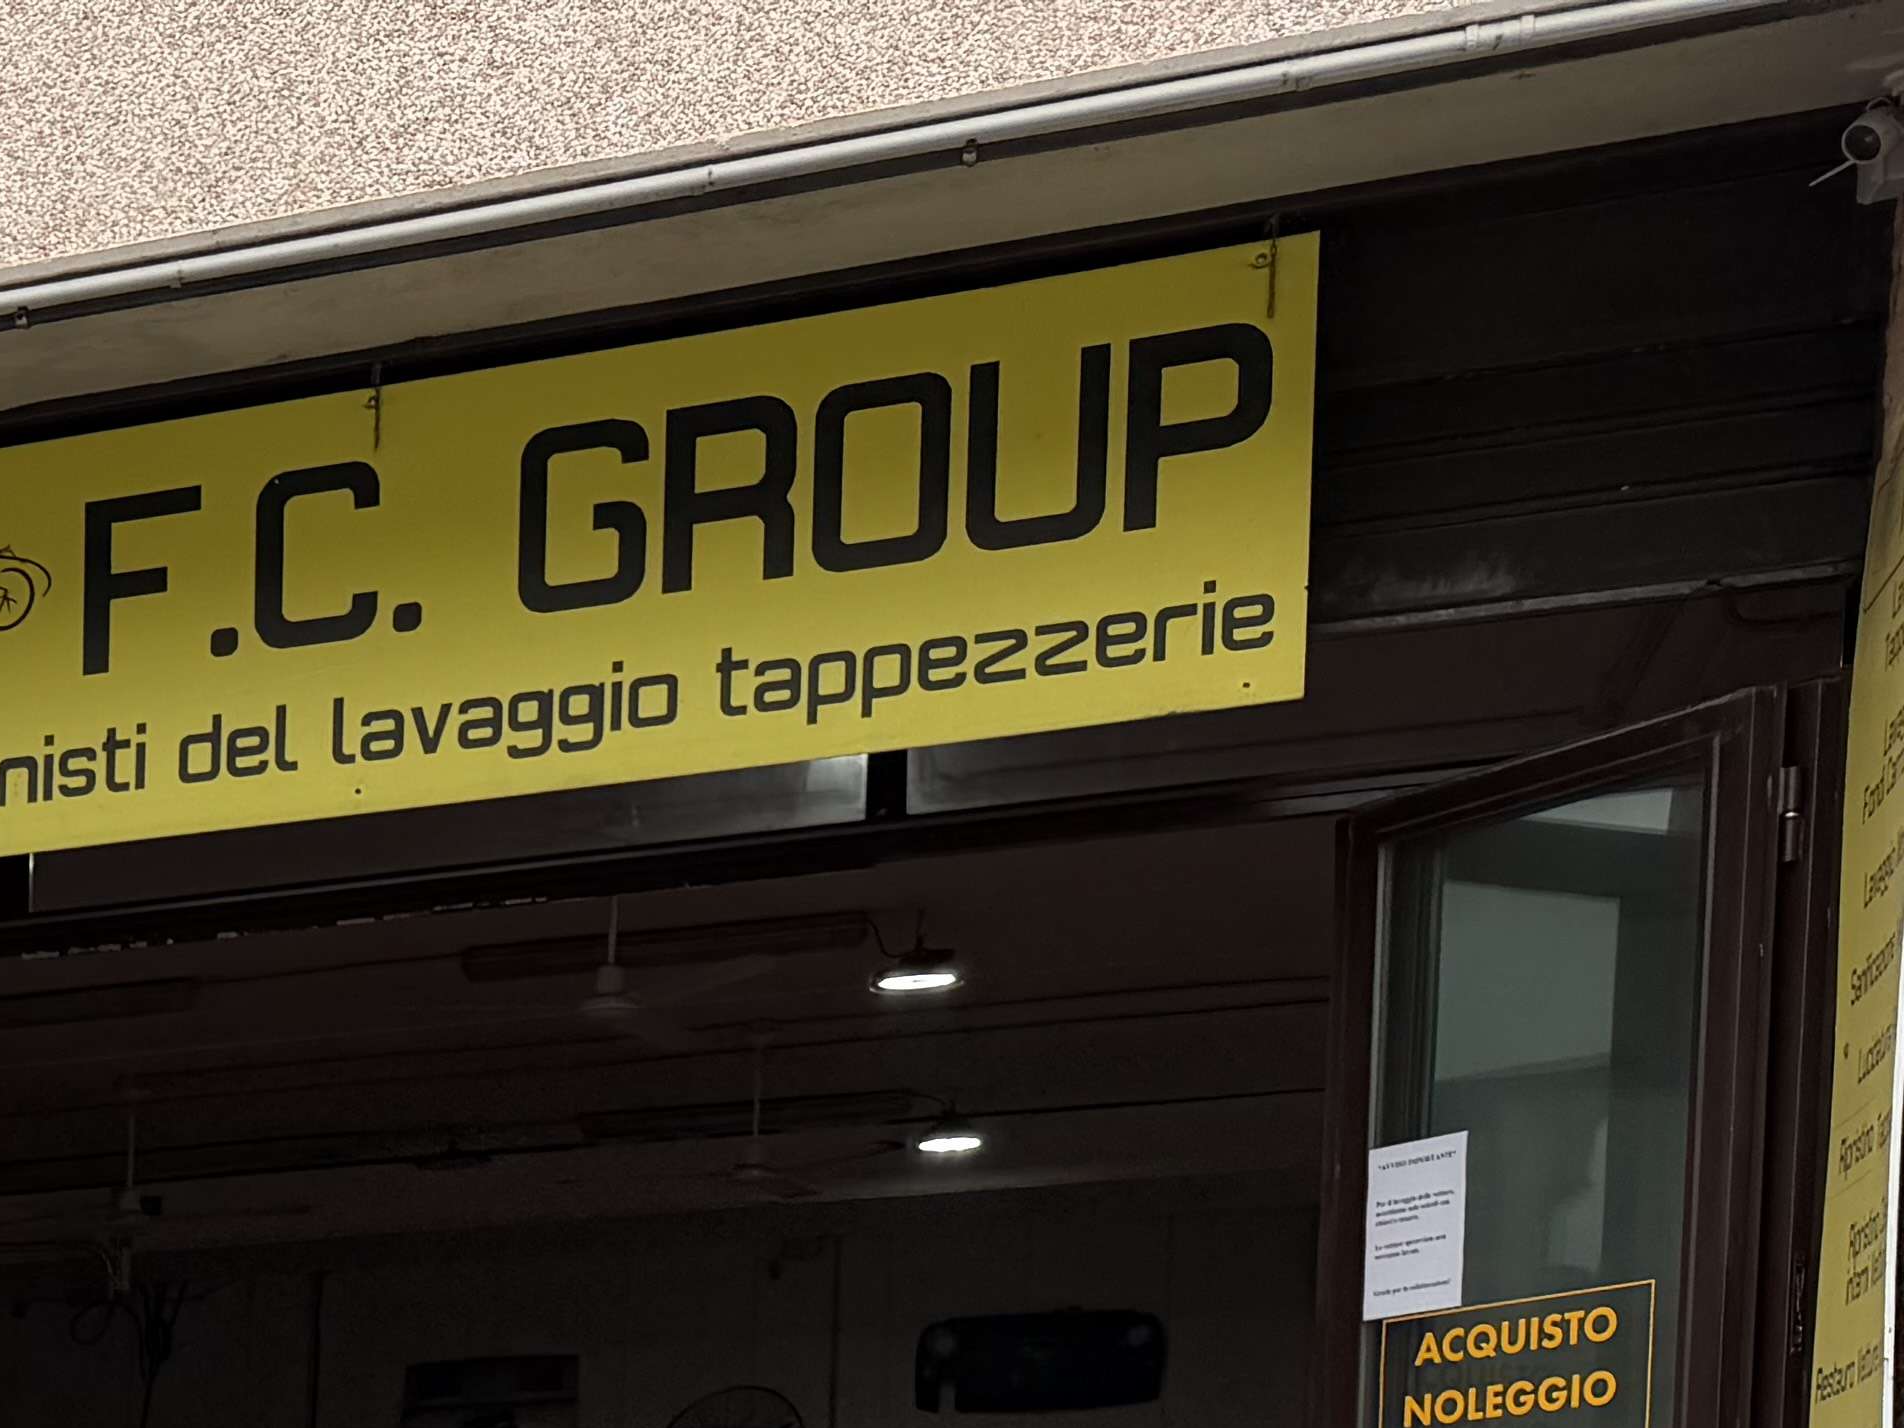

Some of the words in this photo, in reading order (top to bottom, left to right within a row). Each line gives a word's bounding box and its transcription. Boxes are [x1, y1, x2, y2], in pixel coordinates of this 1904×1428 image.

[83, 459, 424, 676] F.C.
[519, 322, 1273, 613] GROUP
[178, 702, 297, 783] del
[334, 669, 680, 772] lavaggio
[717, 581, 1274, 722] tappezzerie
[1403, 1370, 1617, 1428] NOLEGGIO
[1414, 1306, 1618, 1367] ACQUISTO
